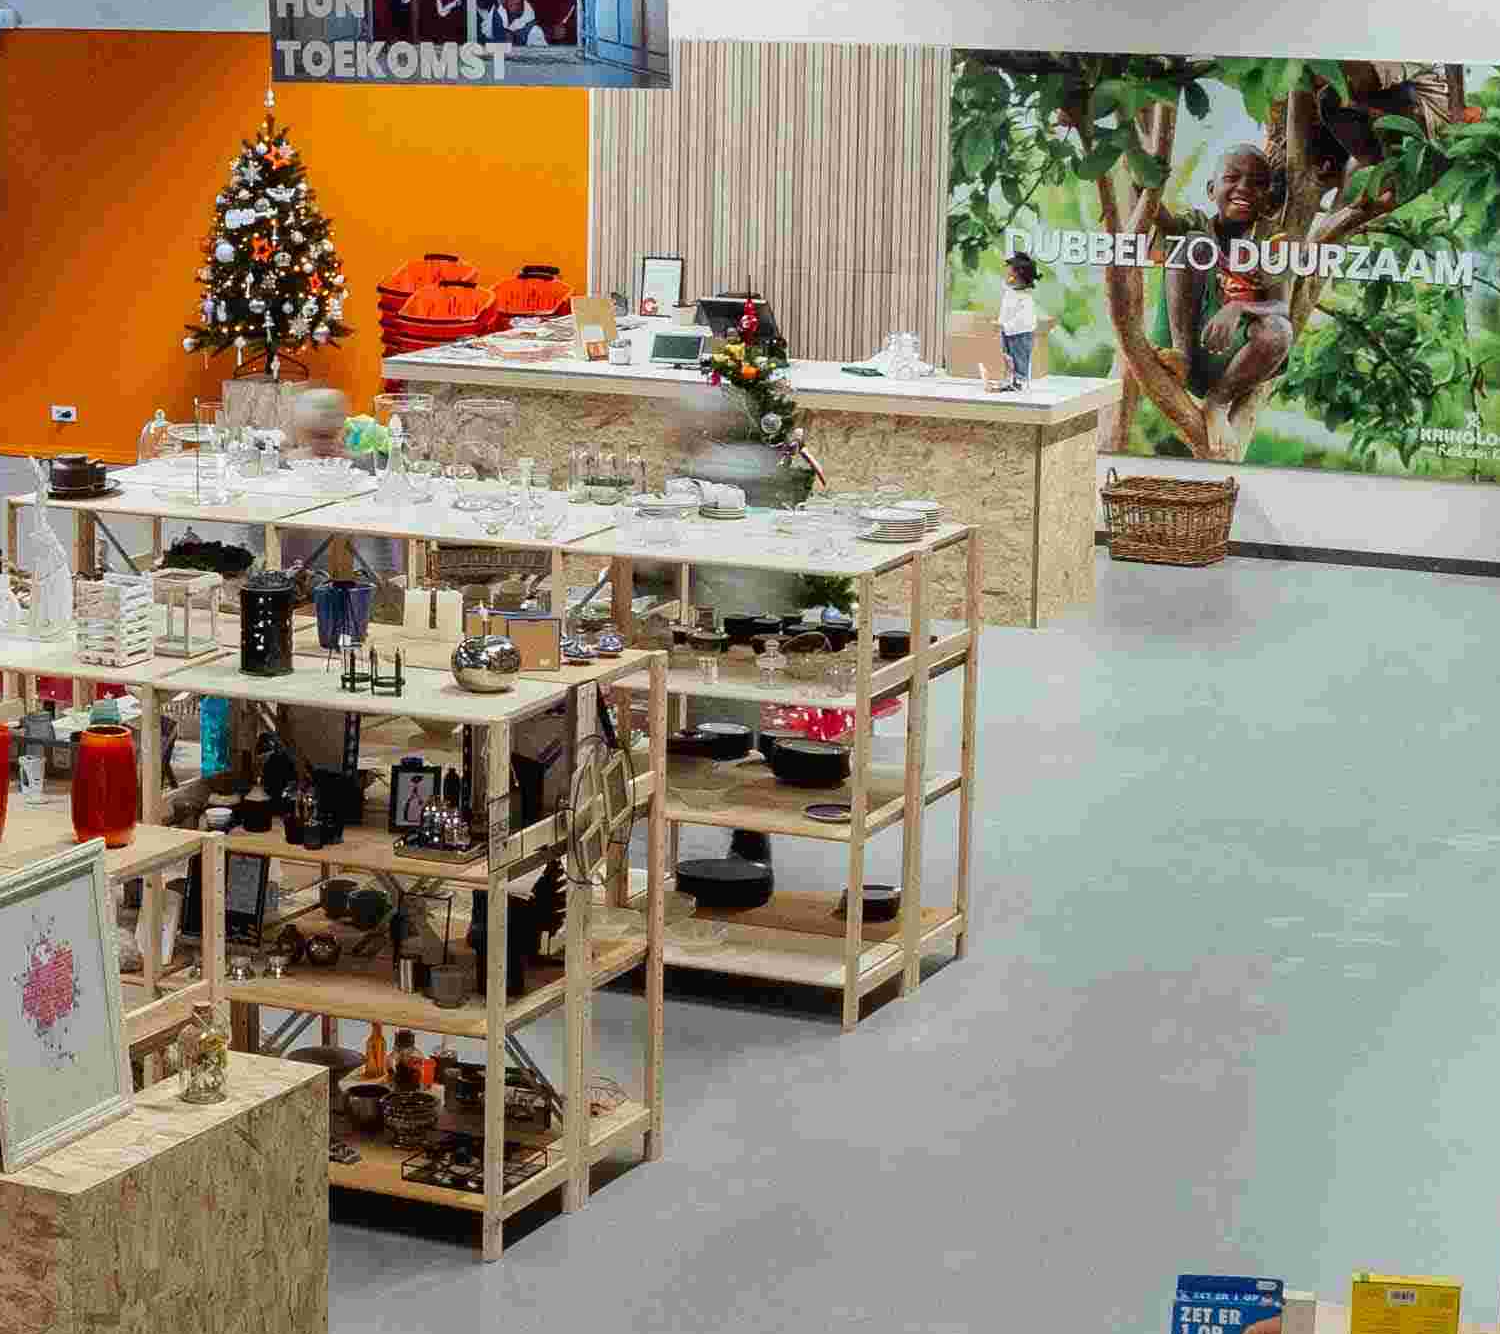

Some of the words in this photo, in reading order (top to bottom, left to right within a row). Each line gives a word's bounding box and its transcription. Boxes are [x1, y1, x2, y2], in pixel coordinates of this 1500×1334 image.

[276, 40, 513, 80] TOEKOMST
[1004, 228, 1155, 268] DUBBEL
[1165, 235, 1219, 270] ZO
[1229, 237, 1475, 286] DUURZAAM
[1179, 1306, 1213, 1325] ZET
[1218, 1307, 1242, 1325] ER
